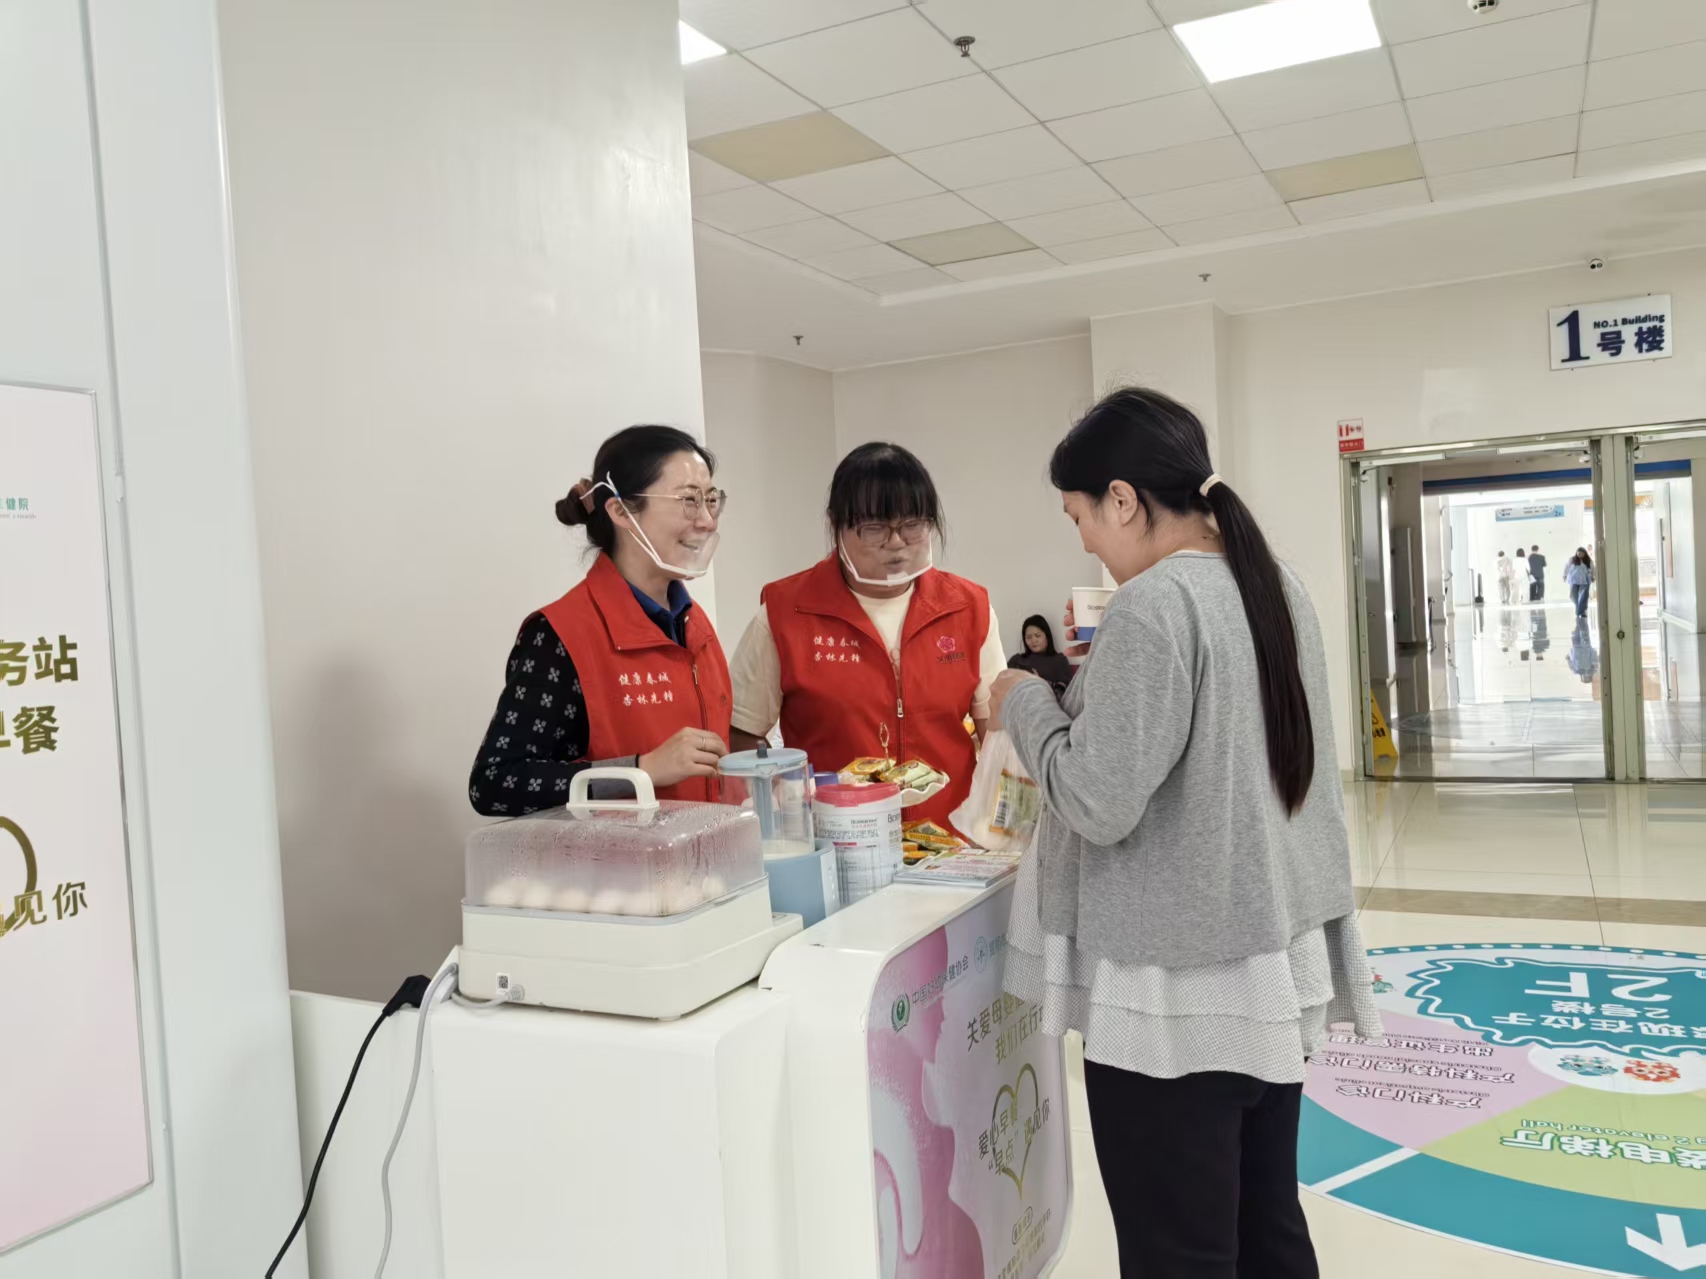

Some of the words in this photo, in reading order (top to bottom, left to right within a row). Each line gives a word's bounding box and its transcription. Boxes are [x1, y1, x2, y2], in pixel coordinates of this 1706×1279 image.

[1593, 317, 1619, 330] NO.1
[1621, 313, 1666, 328] Building
[1556, 310, 1590, 363] 1
[1596, 325, 1666, 358] 号楼
[0, 496, 29, 511] 健院
[0, 705, 60, 755] 餐
[0, 881, 88, 937] 见你
[1524, 971, 1674, 1002] 2F
[1551, 1000, 1670, 1019] 2号楼
[1336, 1084, 1482, 1109] 产科门诊
[1521, 1119, 1564, 1132] hall
[1565, 1123, 1670, 1143] elevator
